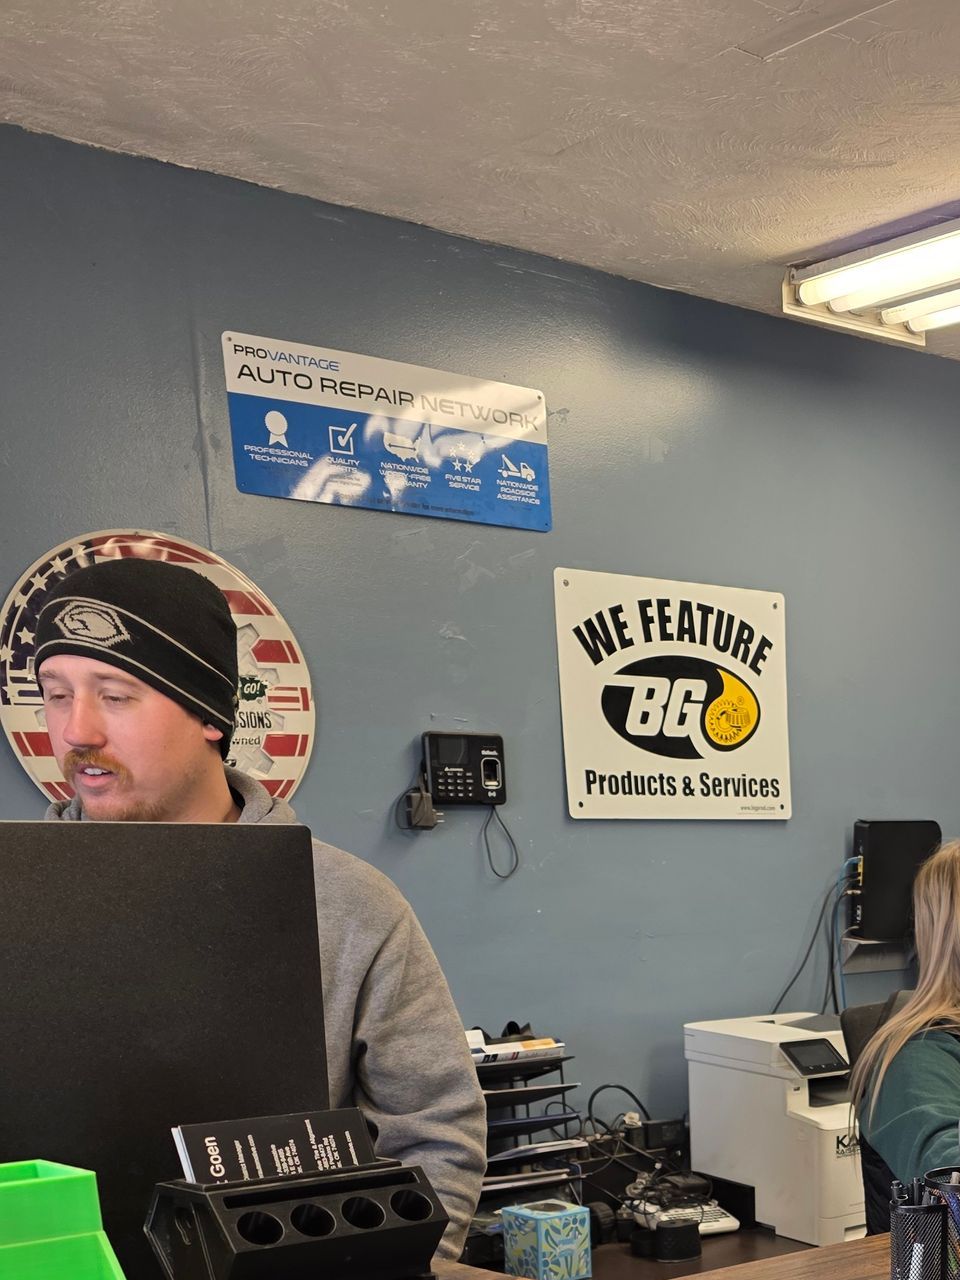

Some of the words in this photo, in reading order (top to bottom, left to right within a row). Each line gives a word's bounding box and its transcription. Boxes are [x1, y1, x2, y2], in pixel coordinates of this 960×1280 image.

[234, 344, 340, 372] PROVANTAGE
[237, 364, 312, 390] AUTO
[320, 377, 415, 408] REPAIR
[421, 394, 538, 431] NETWORK
[244, 444, 313, 460] PROFESSIONAL
[248, 453, 308, 467] TECHNICIANS
[326, 456, 360, 466] QUALITY
[380, 462, 429, 475] NATIONWIDE
[448, 481, 480, 492] SERVICE
[462, 476, 482, 485] STAR
[496, 479, 539, 491] NATIONWIDE
[497, 493, 540, 505] ASSISTANCE
[500, 487, 536, 498] ROADSIDE
[572, 604, 635, 666] WE
[637, 598, 773, 677] FEATURE
[243, 683, 260, 695] GO!
[624, 677, 709, 738] BG
[585, 769, 677, 796] Products
[682, 775, 695, 796] &
[699, 772, 780, 798] Services
[204, 1136, 226, 1177] Goen
